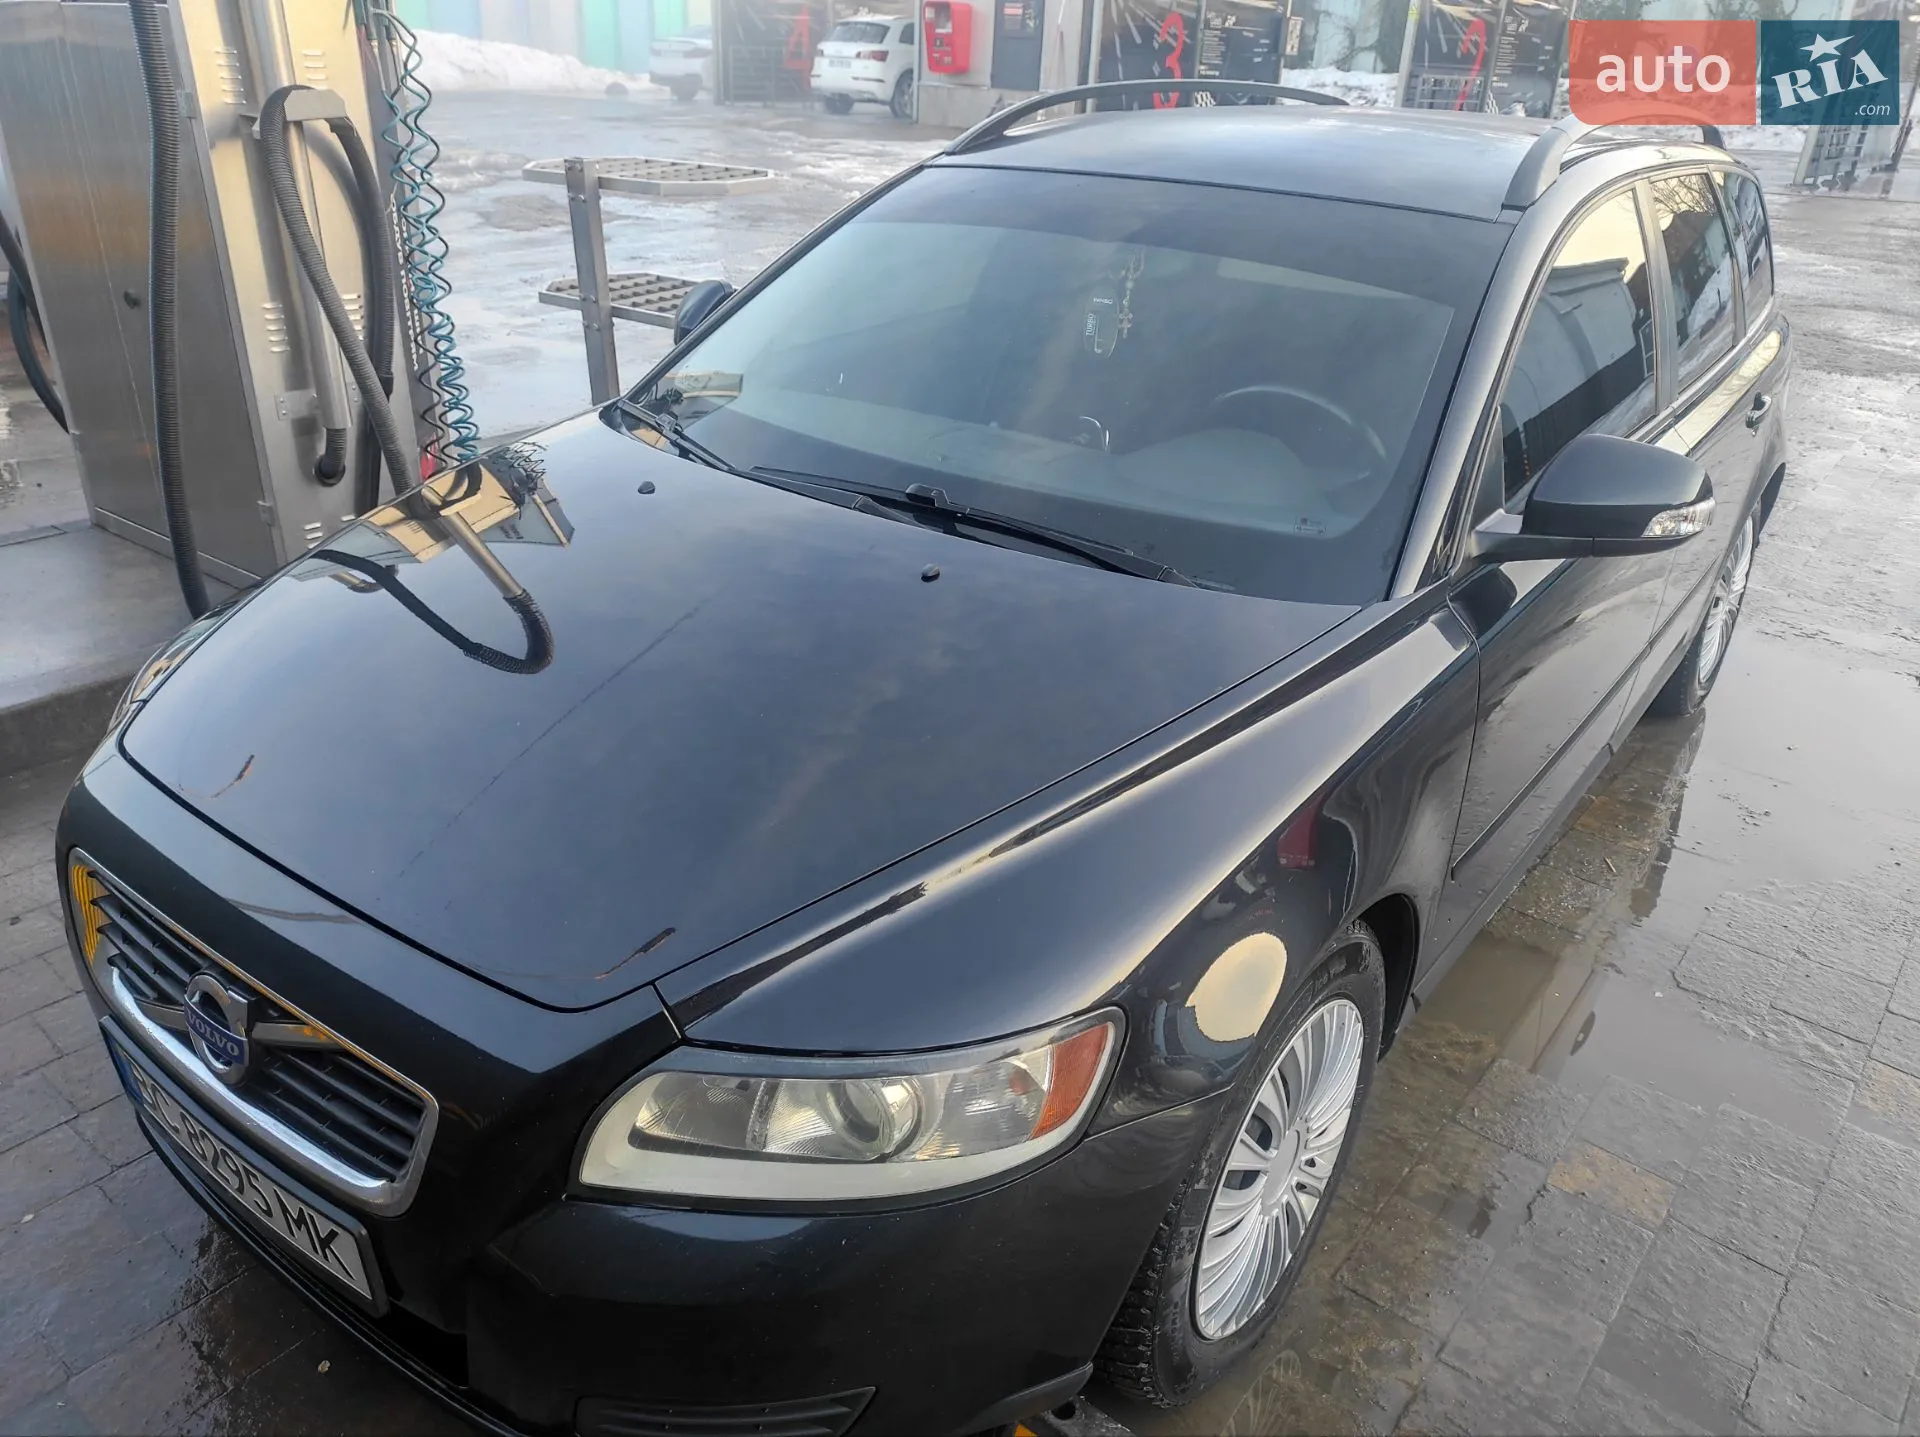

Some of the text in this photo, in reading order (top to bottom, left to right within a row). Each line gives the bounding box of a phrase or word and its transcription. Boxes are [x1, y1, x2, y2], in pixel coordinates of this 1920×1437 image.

[186, 1006, 240, 1056] VOLVO
[179, 1111, 274, 1218] 8295
[273, 1185, 357, 1281] MK
